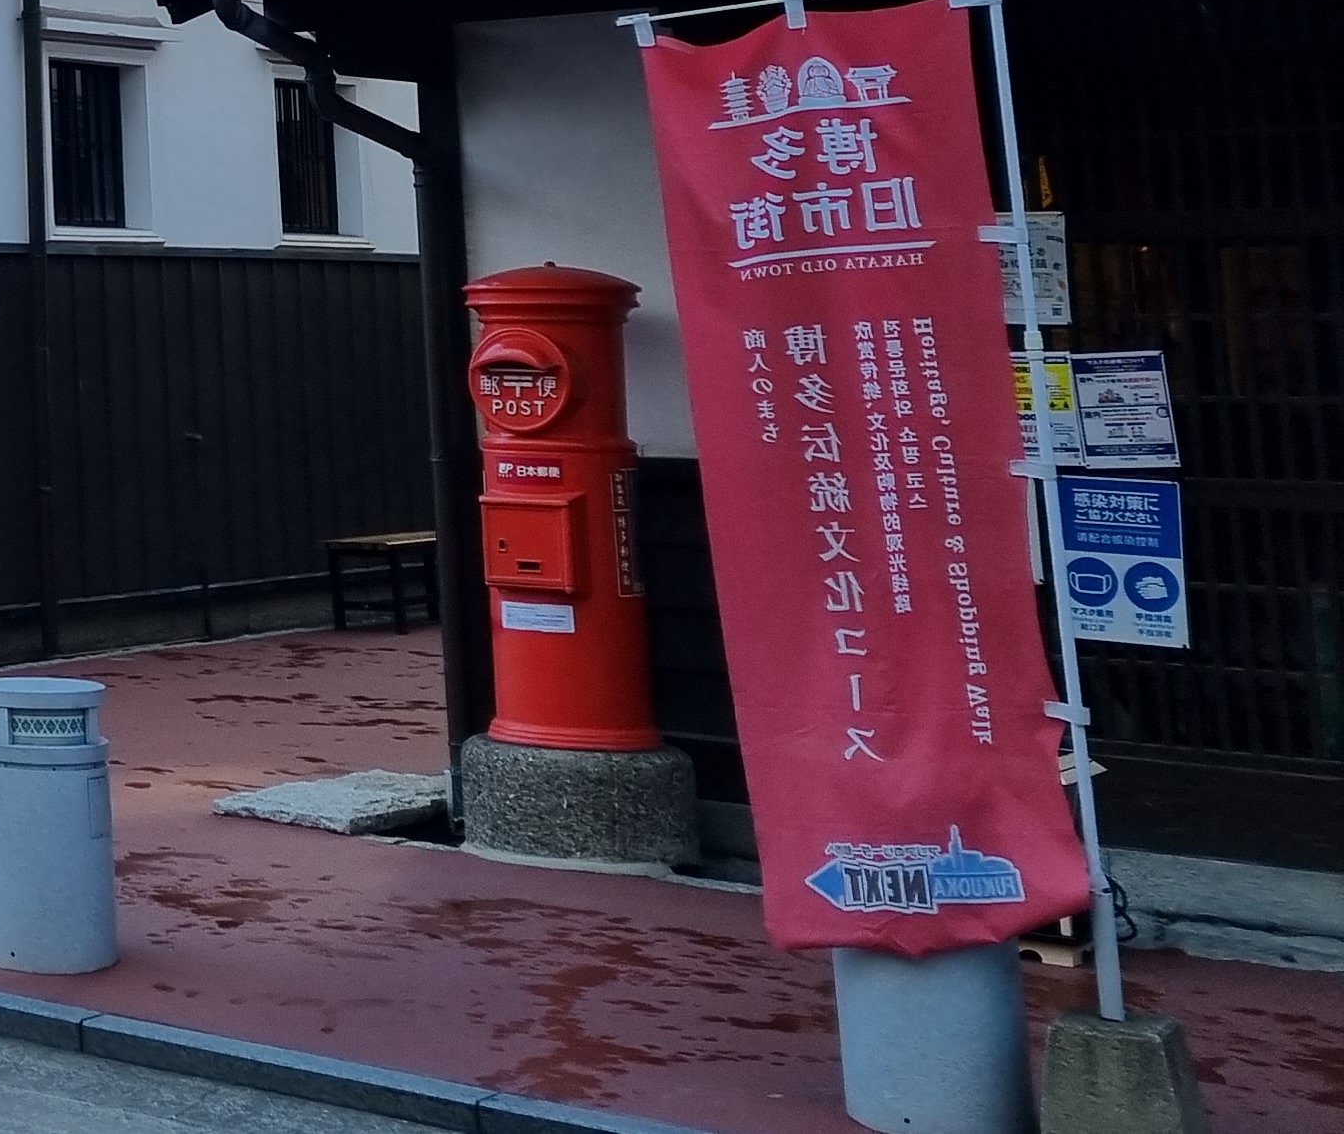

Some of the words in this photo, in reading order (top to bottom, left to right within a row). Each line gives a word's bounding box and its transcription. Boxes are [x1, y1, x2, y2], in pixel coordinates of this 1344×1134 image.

[492, 399, 545, 416] POST
[516, 466, 561, 478] 日本郵便
[1073, 492, 1160, 511] 感染対策に
[1075, 509, 1159, 524] ご協力ください
